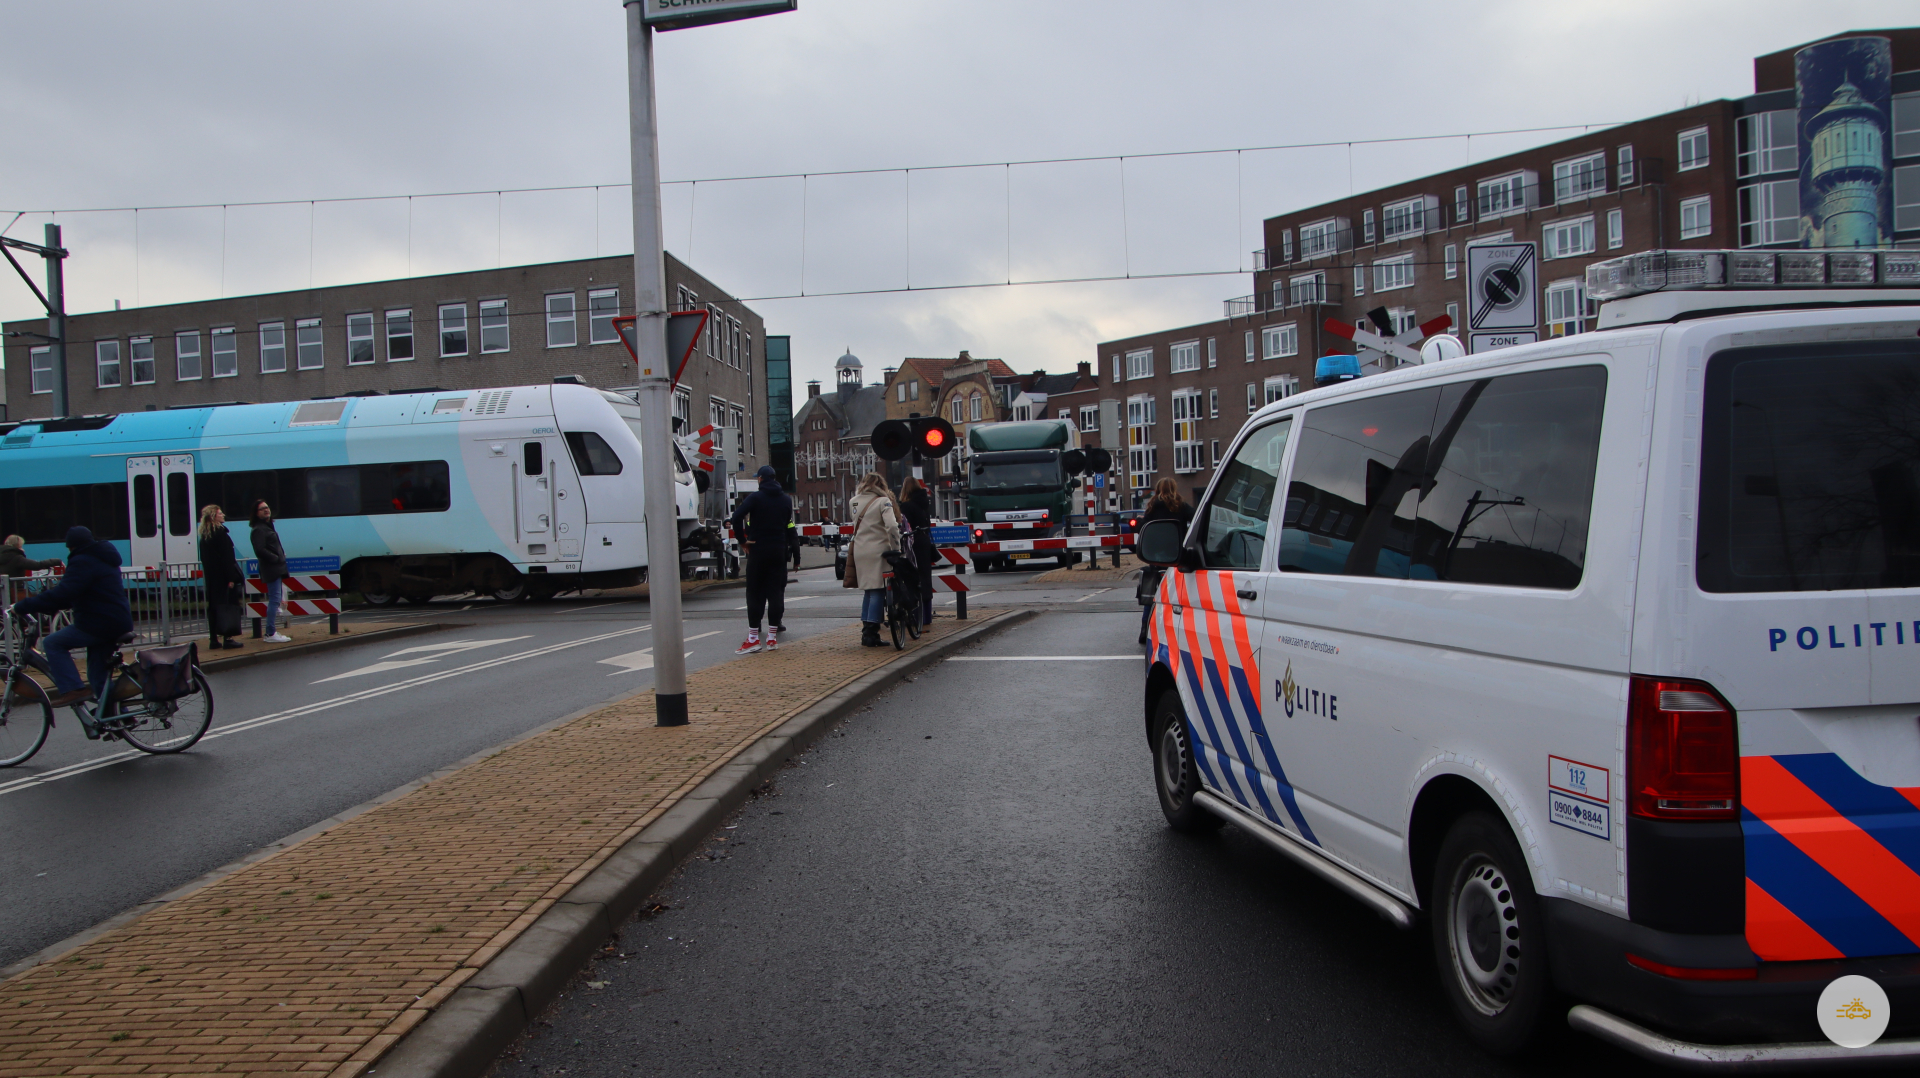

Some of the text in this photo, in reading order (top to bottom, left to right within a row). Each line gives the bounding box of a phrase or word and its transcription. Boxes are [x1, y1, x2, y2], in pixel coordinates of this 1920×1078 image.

[1487, 249, 1516, 259] ZONE
[1490, 336, 1518, 346] ZONE
[128, 460, 133, 468] 2
[186, 456, 192, 465] 2
[1096, 474, 1102, 482] P
[1281, 635, 1336, 655] waakzaam en dienstbaar
[1275, 678, 1338, 721] POLITIE
[1554, 800, 1602, 825] 0900 8844
